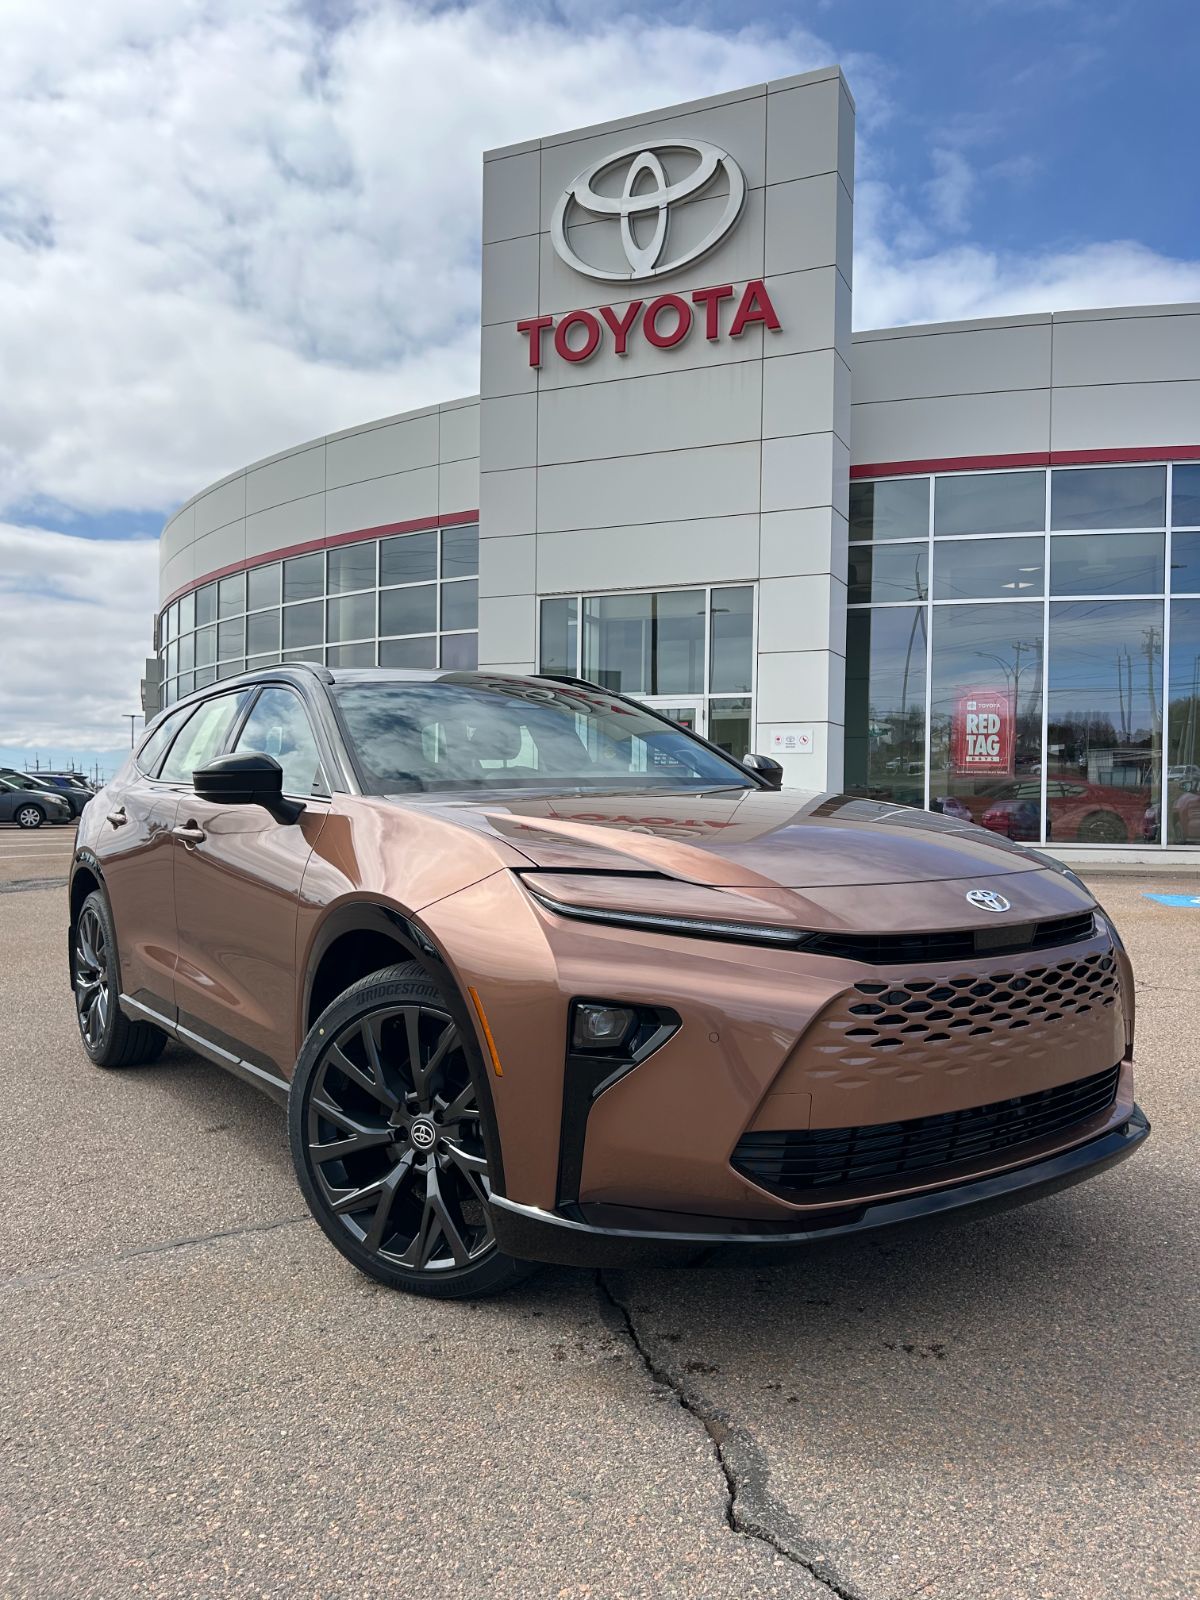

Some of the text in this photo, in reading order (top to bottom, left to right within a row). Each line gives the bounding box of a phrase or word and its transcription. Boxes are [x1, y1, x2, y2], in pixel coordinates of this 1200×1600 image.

[516, 279, 782, 369] TOYOTA
[966, 713, 1000, 734] RED
[966, 734, 1000, 755] TAG
[355, 983, 440, 1006] BRIDGESTONE
